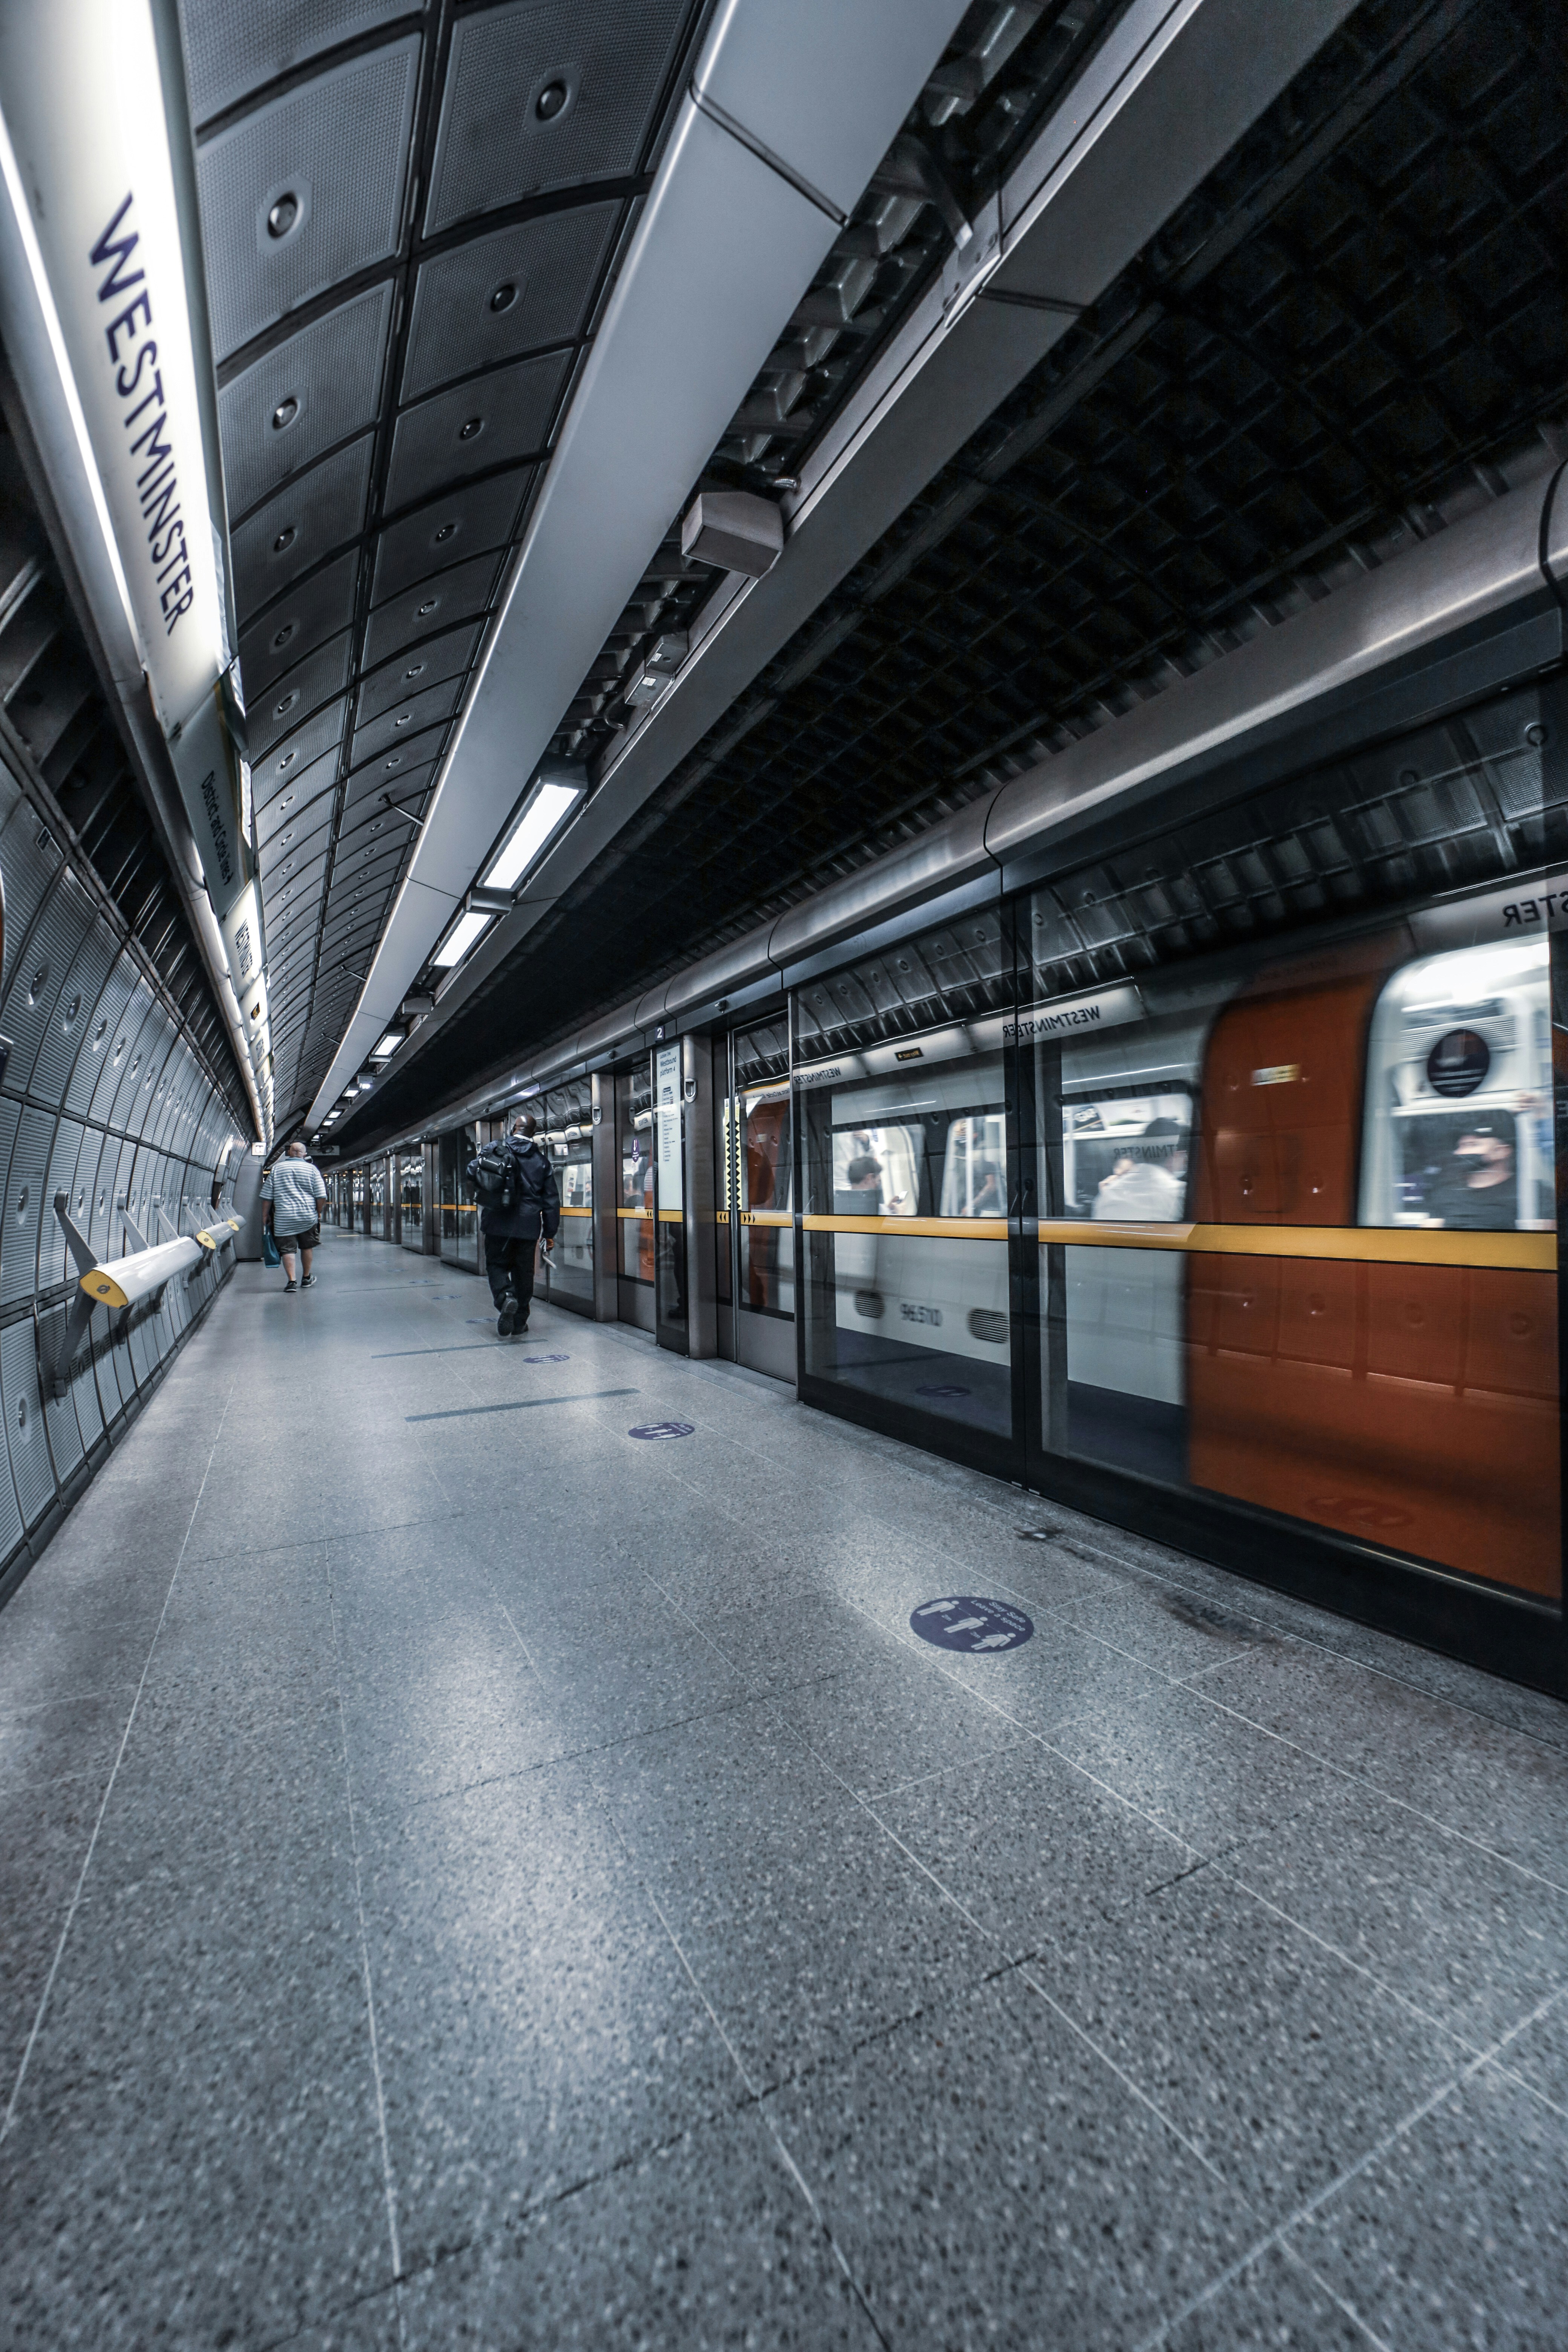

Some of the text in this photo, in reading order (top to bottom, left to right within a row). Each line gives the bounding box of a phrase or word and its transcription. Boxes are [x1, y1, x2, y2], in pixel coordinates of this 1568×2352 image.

[89, 190, 194, 637] WESTMINSTER
[201, 770, 219, 820] District
[235, 919, 253, 979] WESTMINSTER
[657, 1027, 662, 1038] 2
[660, 1056, 677, 1067] Westbound
[660, 1067, 672, 1077] platform
[971, 1600, 994, 1614] Leave
[1001, 1617, 1026, 1632] space
[989, 1602, 1026, 1623] Stay Safe
